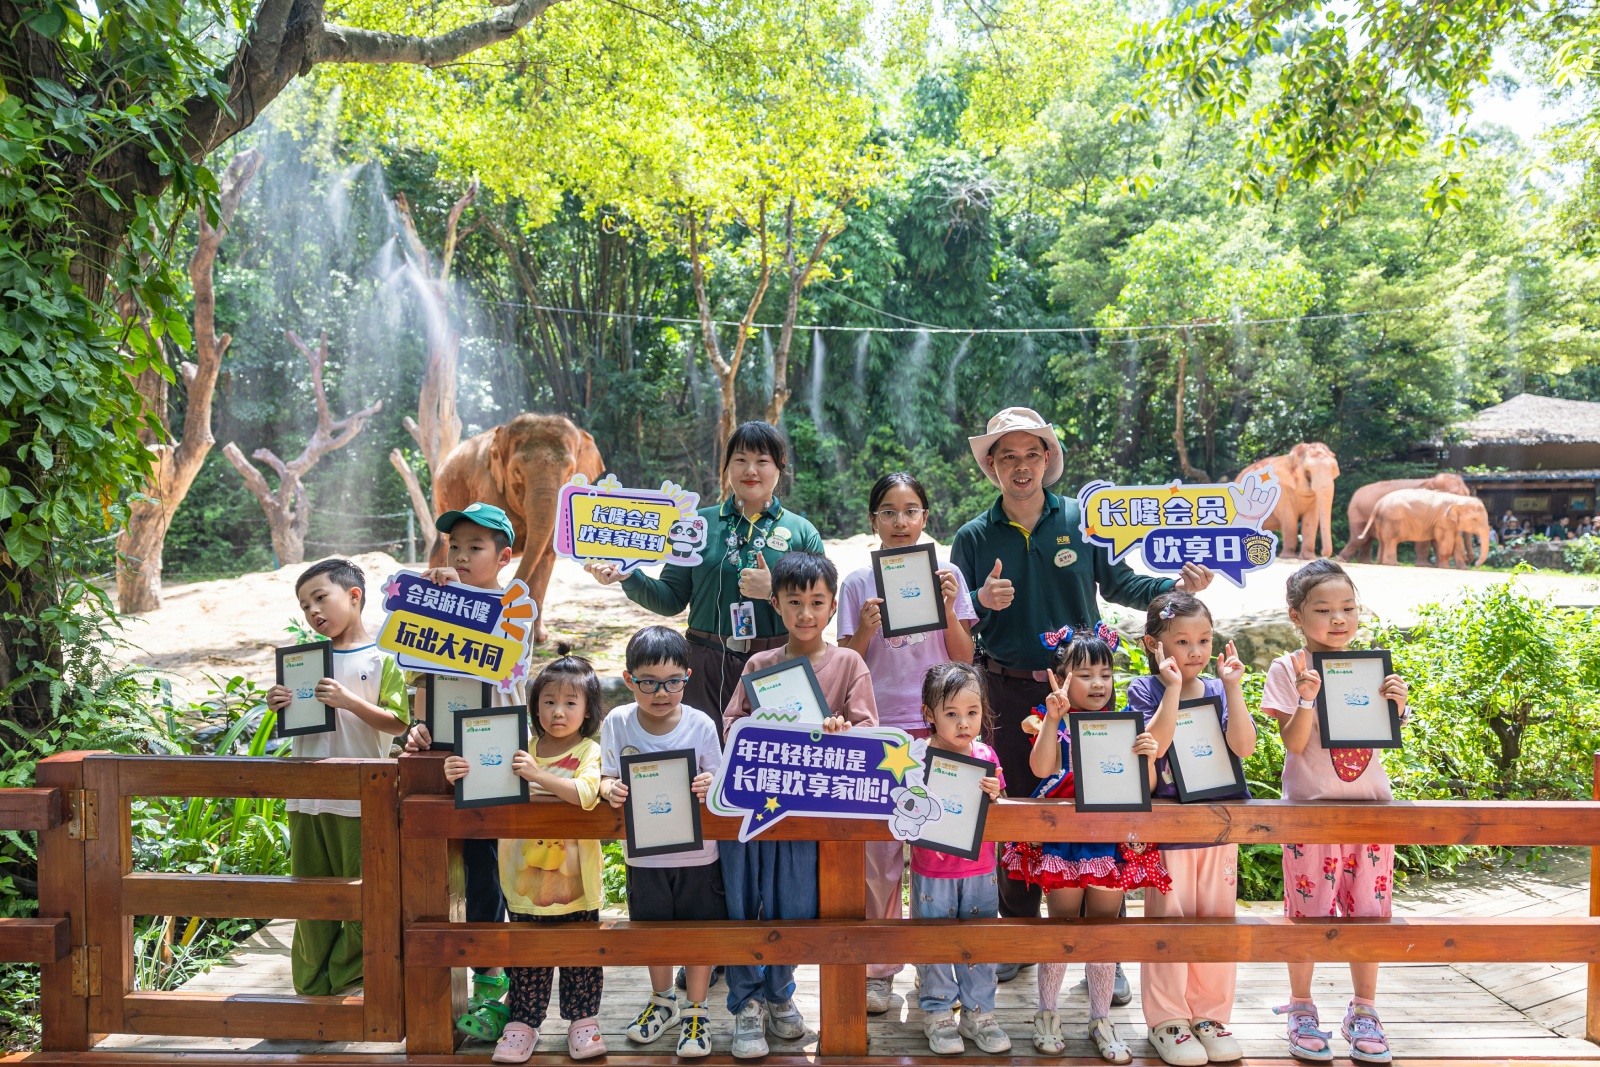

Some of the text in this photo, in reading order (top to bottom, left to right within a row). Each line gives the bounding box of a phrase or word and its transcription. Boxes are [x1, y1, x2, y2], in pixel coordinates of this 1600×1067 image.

[591, 504, 661, 531] 长隆会员
[1098, 497, 1229, 527] 长隆会员
[577, 524, 666, 553] 欢享家驾到
[1152, 535, 1242, 563] 欢享日
[1243, 535, 1273, 544] CHIMELONG
[405, 583, 491, 623] 会员游长隆
[394, 621, 504, 672] 玩出大不同
[736, 738, 867, 772] 年纪轻轻就是
[732, 765, 889, 804] 长隆欢享家啦!
